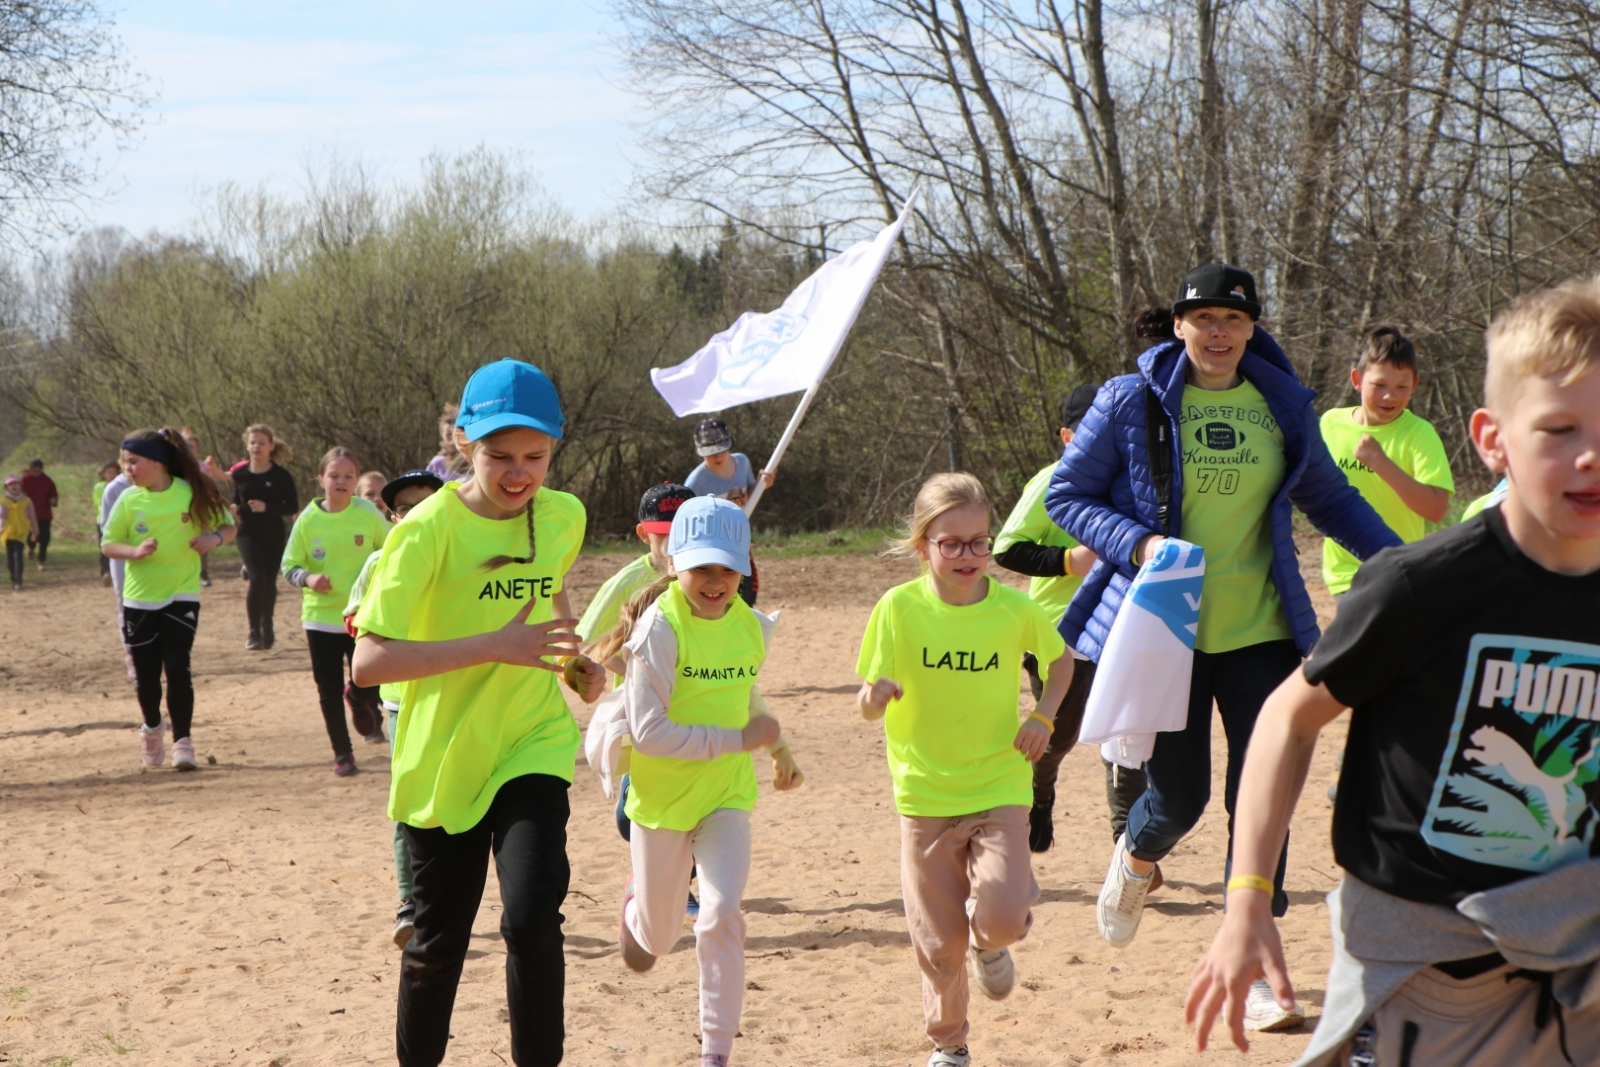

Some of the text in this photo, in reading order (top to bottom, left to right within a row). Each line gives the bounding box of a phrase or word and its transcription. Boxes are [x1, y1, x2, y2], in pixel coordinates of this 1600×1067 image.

[1182, 448, 1261, 466] Knoxville
[1196, 467, 1241, 496] 70
[478, 576, 554, 601] ANETE
[922, 646, 999, 673] LAILA
[682, 666, 746, 680] SAMANTA
[1477, 658, 1600, 722] PUM
